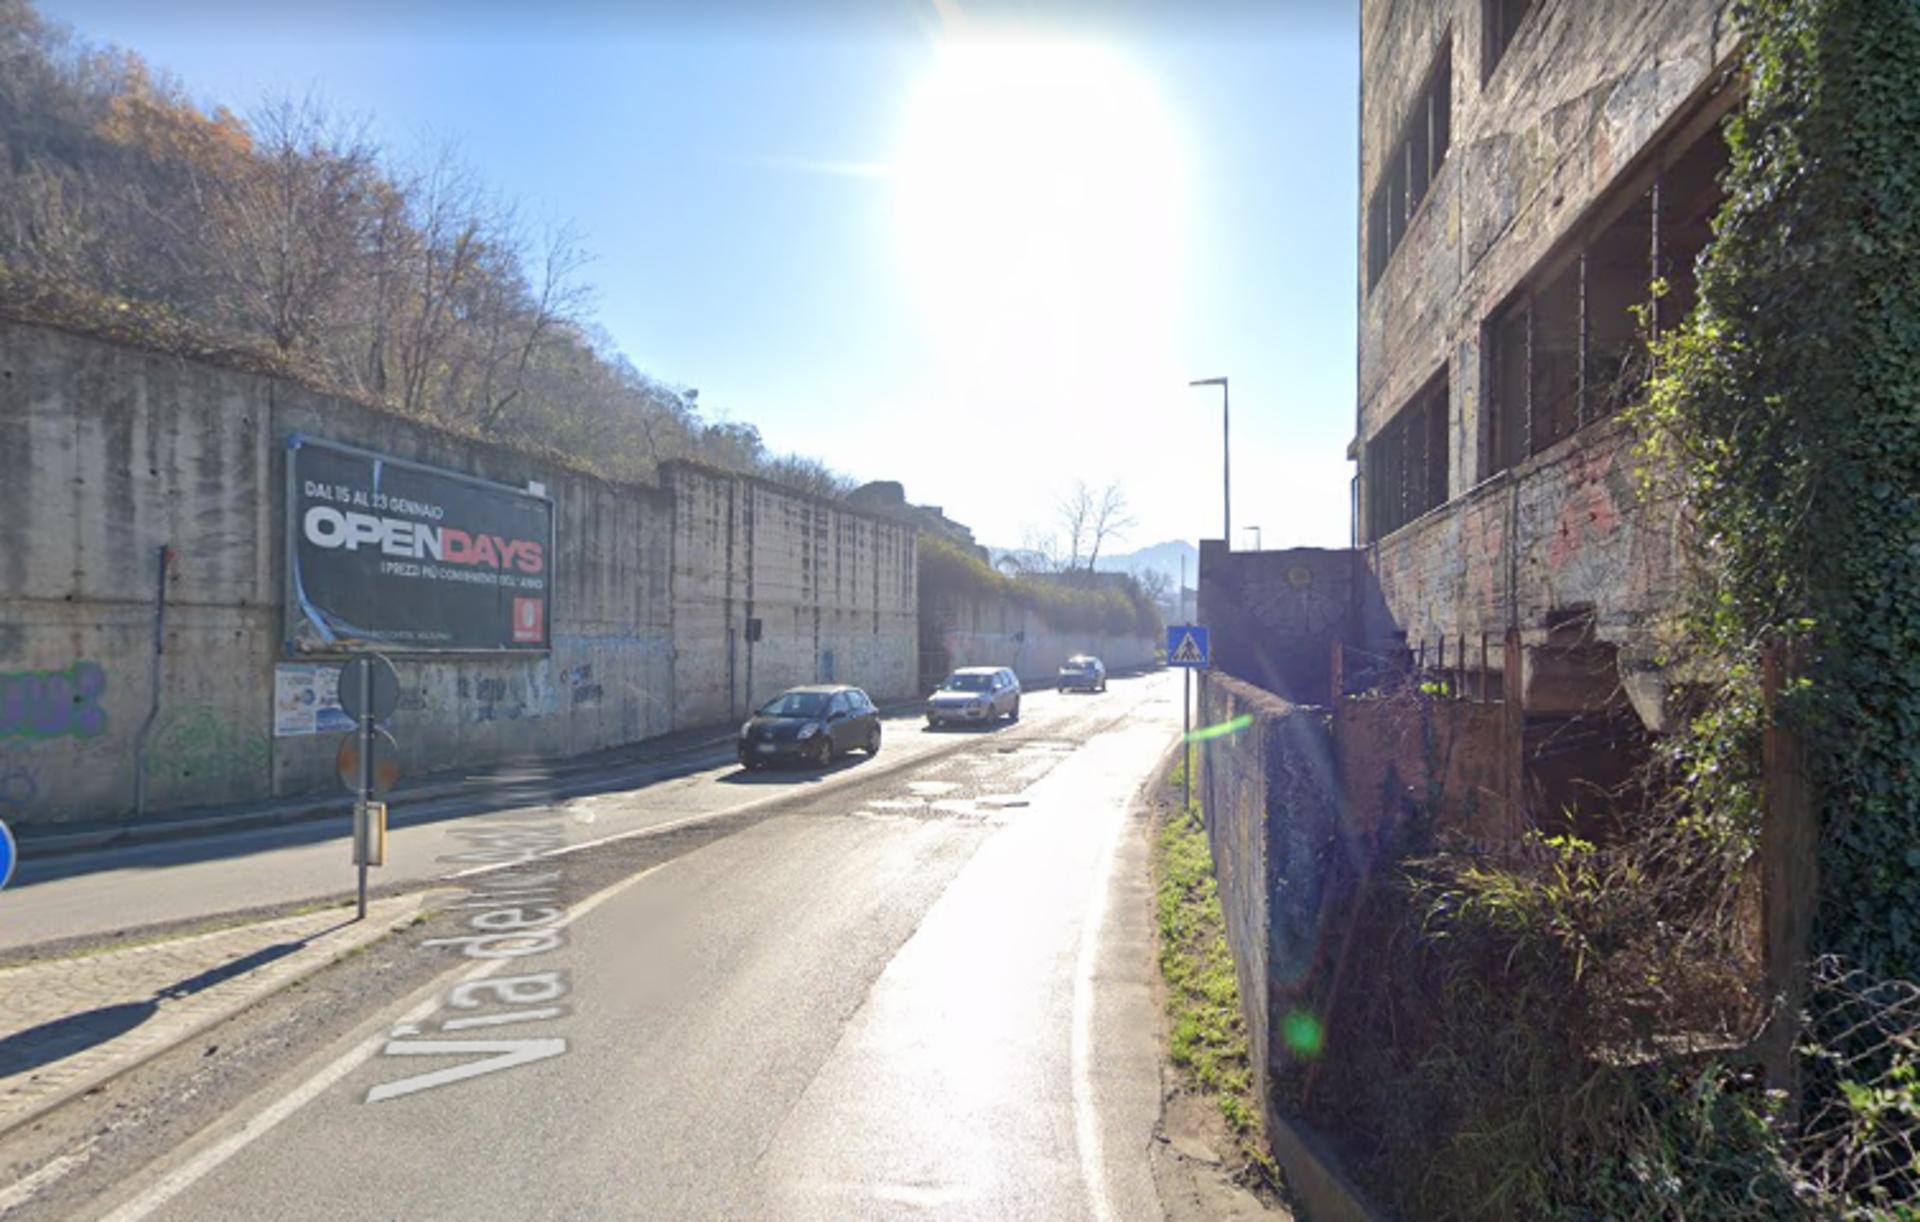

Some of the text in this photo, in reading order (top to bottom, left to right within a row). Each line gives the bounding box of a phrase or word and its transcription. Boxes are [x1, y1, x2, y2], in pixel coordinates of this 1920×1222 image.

[305, 480, 333, 501] DAL
[353, 490, 370, 508] AL
[389, 498, 445, 520] GENNAIO
